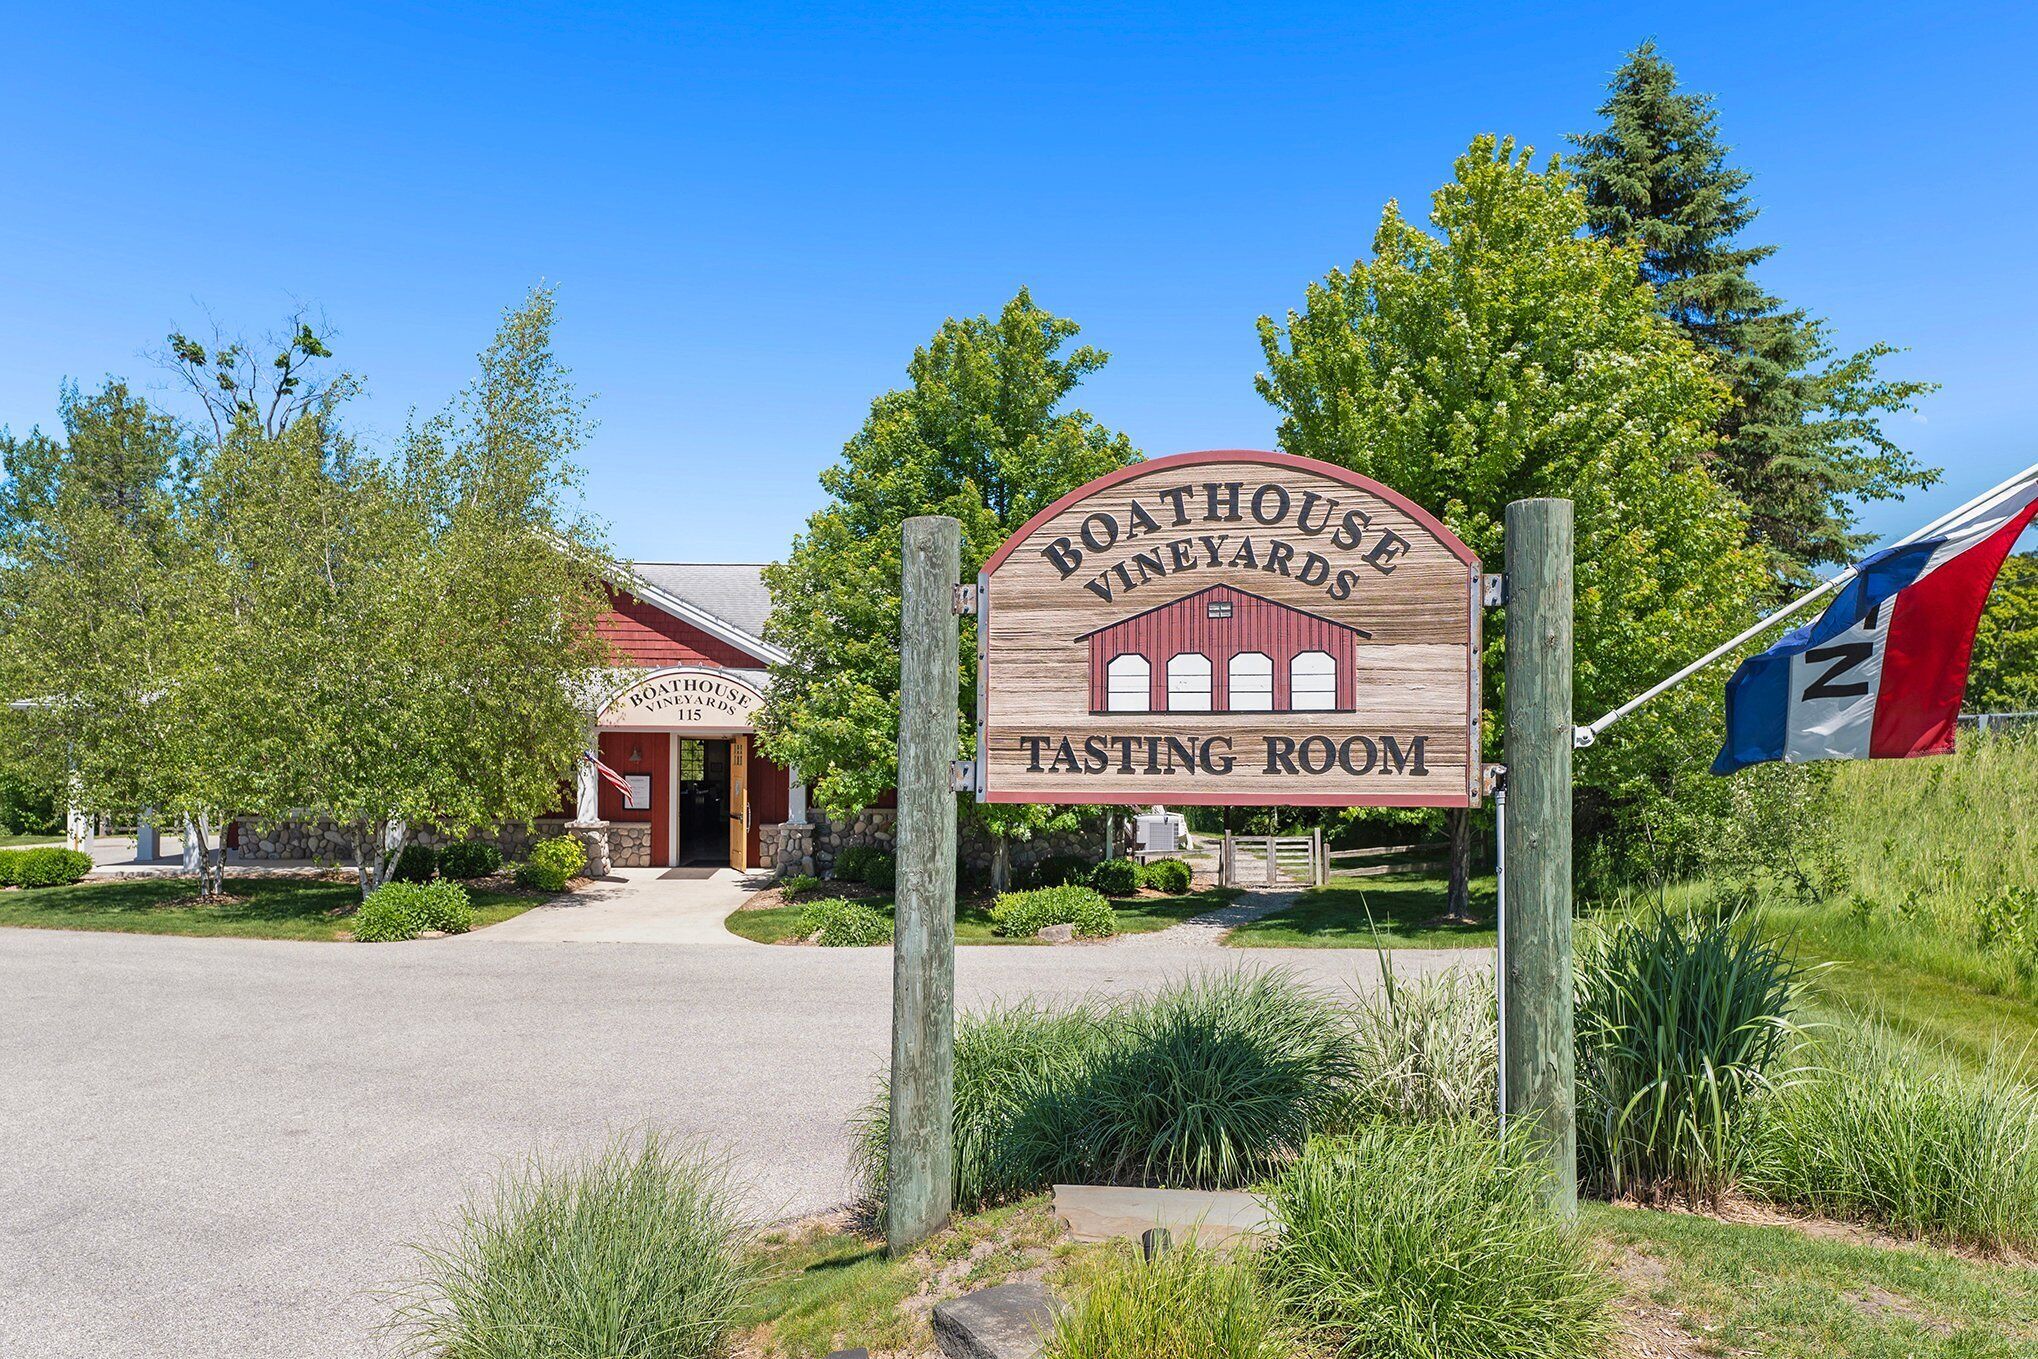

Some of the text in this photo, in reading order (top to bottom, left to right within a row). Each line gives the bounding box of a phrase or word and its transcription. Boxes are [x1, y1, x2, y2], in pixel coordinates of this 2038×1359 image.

[1041, 482, 1411, 581] BOATHOUSE
[1083, 534, 1360, 602] VINEYARDS
[629, 679, 752, 709] BOATHOUSE
[646, 695, 737, 716] VINEYARDS
[679, 709, 702, 721] 115
[1020, 734, 1429, 776] TASTING ROOM
